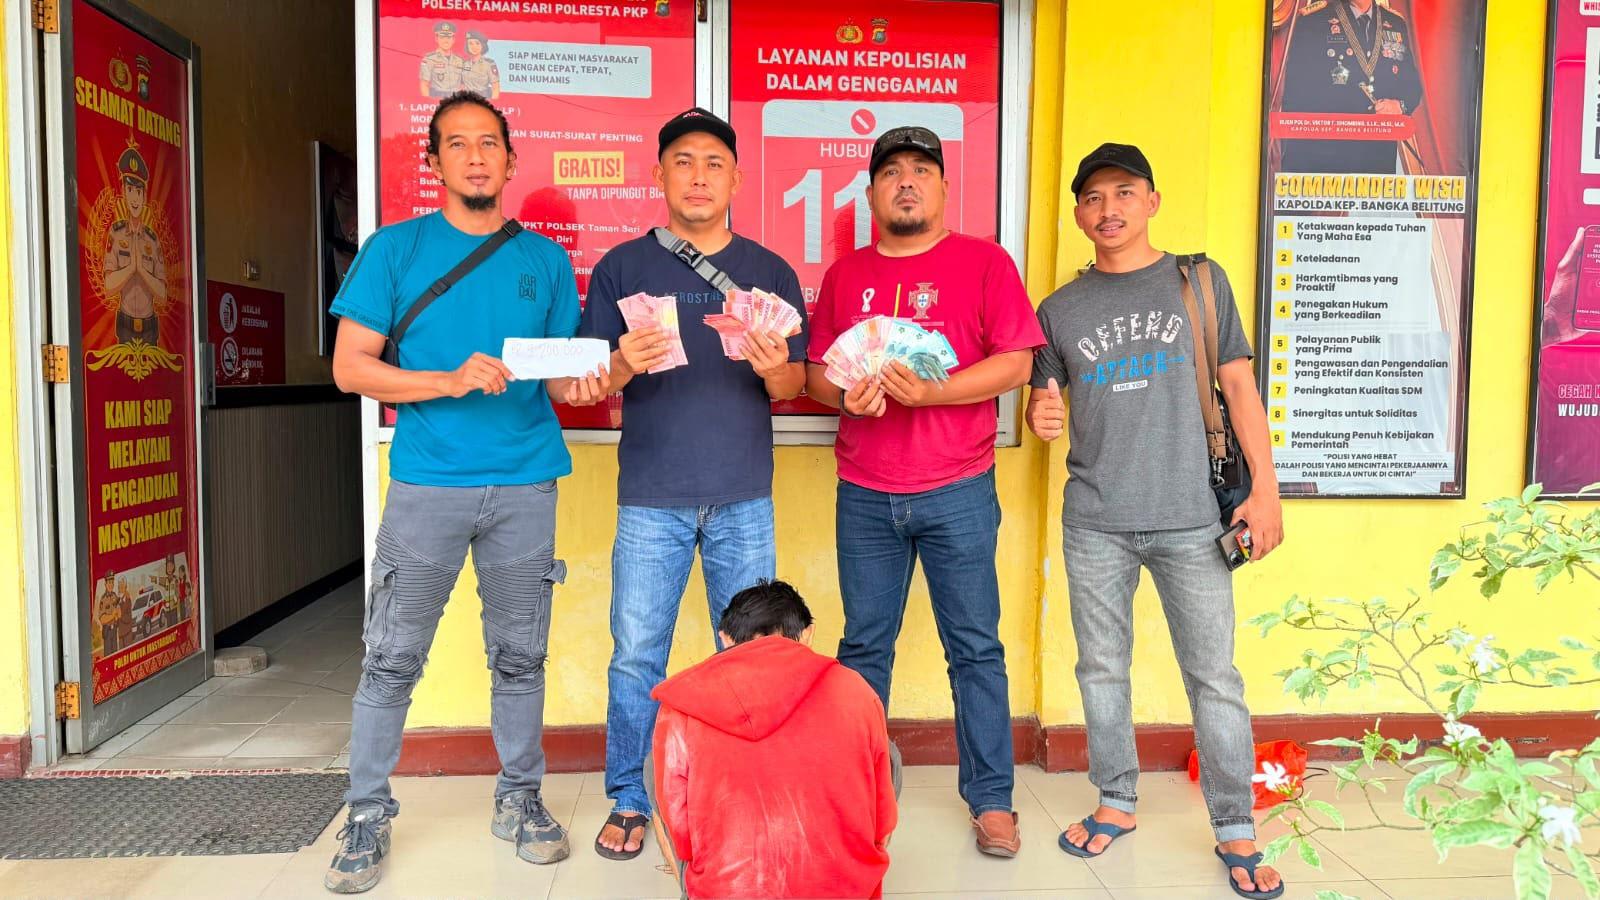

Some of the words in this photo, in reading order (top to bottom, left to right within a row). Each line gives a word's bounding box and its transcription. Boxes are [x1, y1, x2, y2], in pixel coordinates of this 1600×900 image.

[422, 0, 471, 10] POLSEK
[474, 1, 519, 12] TAMAN
[523, 3, 551, 13] SARI
[556, 4, 620, 16] POLRESTA
[623, 7, 648, 18] PKP
[509, 51, 528, 59] SIAP
[531, 52, 577, 61] MELAYANI
[579, 54, 639, 64] MASYARAKAT
[758, 48, 848, 66] LAYANAN
[854, 50, 966, 69] KEPOLISIAN
[509, 63, 545, 72] DENGAN
[548, 65, 579, 74] CEPAT,
[581, 66, 611, 75] TEPAT,
[509, 74, 527, 82] DAN
[529, 75, 570, 84] HUMANIS
[766, 73, 832, 91] DALAM
[838, 75, 957, 94] GENGGAMAN
[75, 76, 135, 127] SELAMAT
[138, 105, 181, 148] DATANG
[410, 104, 437, 112] LAPO
[410, 126, 430, 134] LAP
[530, 130, 596, 140] SURAT-SURAT
[600, 133, 643, 143] PENTING
[559, 158, 620, 178] GRATIS!
[568, 187, 598, 200] TANPA
[601, 187, 646, 199] DIPUNGUT
[1276, 175, 1407, 199] COMMANDER
[1414, 177, 1465, 200] WISH
[419, 190, 438, 198] SIM
[1278, 200, 1332, 210] KAPOLDA
[1335, 201, 1358, 210] KEP.
[1361, 201, 1409, 211] BANGKA
[1412, 202, 1464, 212] BELITUNG
[784, 168, 873, 264] 11
[547, 223, 584, 231] POLSEK
[589, 224, 619, 232] Taman
[622, 225, 640, 233] Sari
[1297, 222, 1354, 231] Ketakwaan
[1356, 223, 1393, 234] kepada
[1395, 224, 1425, 232] Tuhan
[1297, 232, 1322, 243] Yang
[1325, 232, 1353, 241] Maha
[1355, 233, 1371, 241] Esa
[1296, 254, 1360, 264] Keteladanan
[1296, 274, 1371, 283] Harkamtibmas
[1373, 276, 1398, 285] yang
[1296, 283, 1336, 292] Proaktif
[1295, 300, 1350, 311] Penegakan
[1353, 301, 1388, 309] Hukum
[1295, 312, 1320, 321] yang
[1322, 311, 1381, 319] Berkeadilan
[1296, 335, 1349, 346] Pelayanan
[1351, 335, 1381, 344] Publik
[1296, 347, 1321, 355] yang
[1323, 345, 1352, 354] Prima
[1295, 359, 1359, 369] Pengawasan
[1361, 359, 1379, 368] dan
[1381, 359, 1448, 371] Pengendalian
[1295, 370, 1319, 379] yang
[1322, 369, 1354, 378] Efektif
[1355, 369, 1373, 377] dan
[1376, 369, 1423, 378] Konsisten
[1294, 386, 1357, 397] Peningkatan
[1359, 386, 1400, 395] Kualitas
[1402, 387, 1422, 395] SDM
[1558, 384, 1592, 398] CEGAH
[105, 400, 141, 429] KAMI
[144, 399, 172, 425] SIAP
[1293, 409, 1343, 420] Sinergitas
[1345, 409, 1373, 418] untuk
[1376, 409, 1417, 418] Soliditas
[1558, 404, 1600, 416] WUJUD
[1292, 431, 1350, 442] Mendukung
[1353, 431, 1383, 440] Penuh
[1385, 431, 1434, 441] Kebijakan
[1292, 440, 1349, 449] Pemerintah
[108, 436, 170, 470] MELAYANI
[102, 472, 178, 512] PENGADUAN
[98, 507, 182, 554] MASYARAKAT
